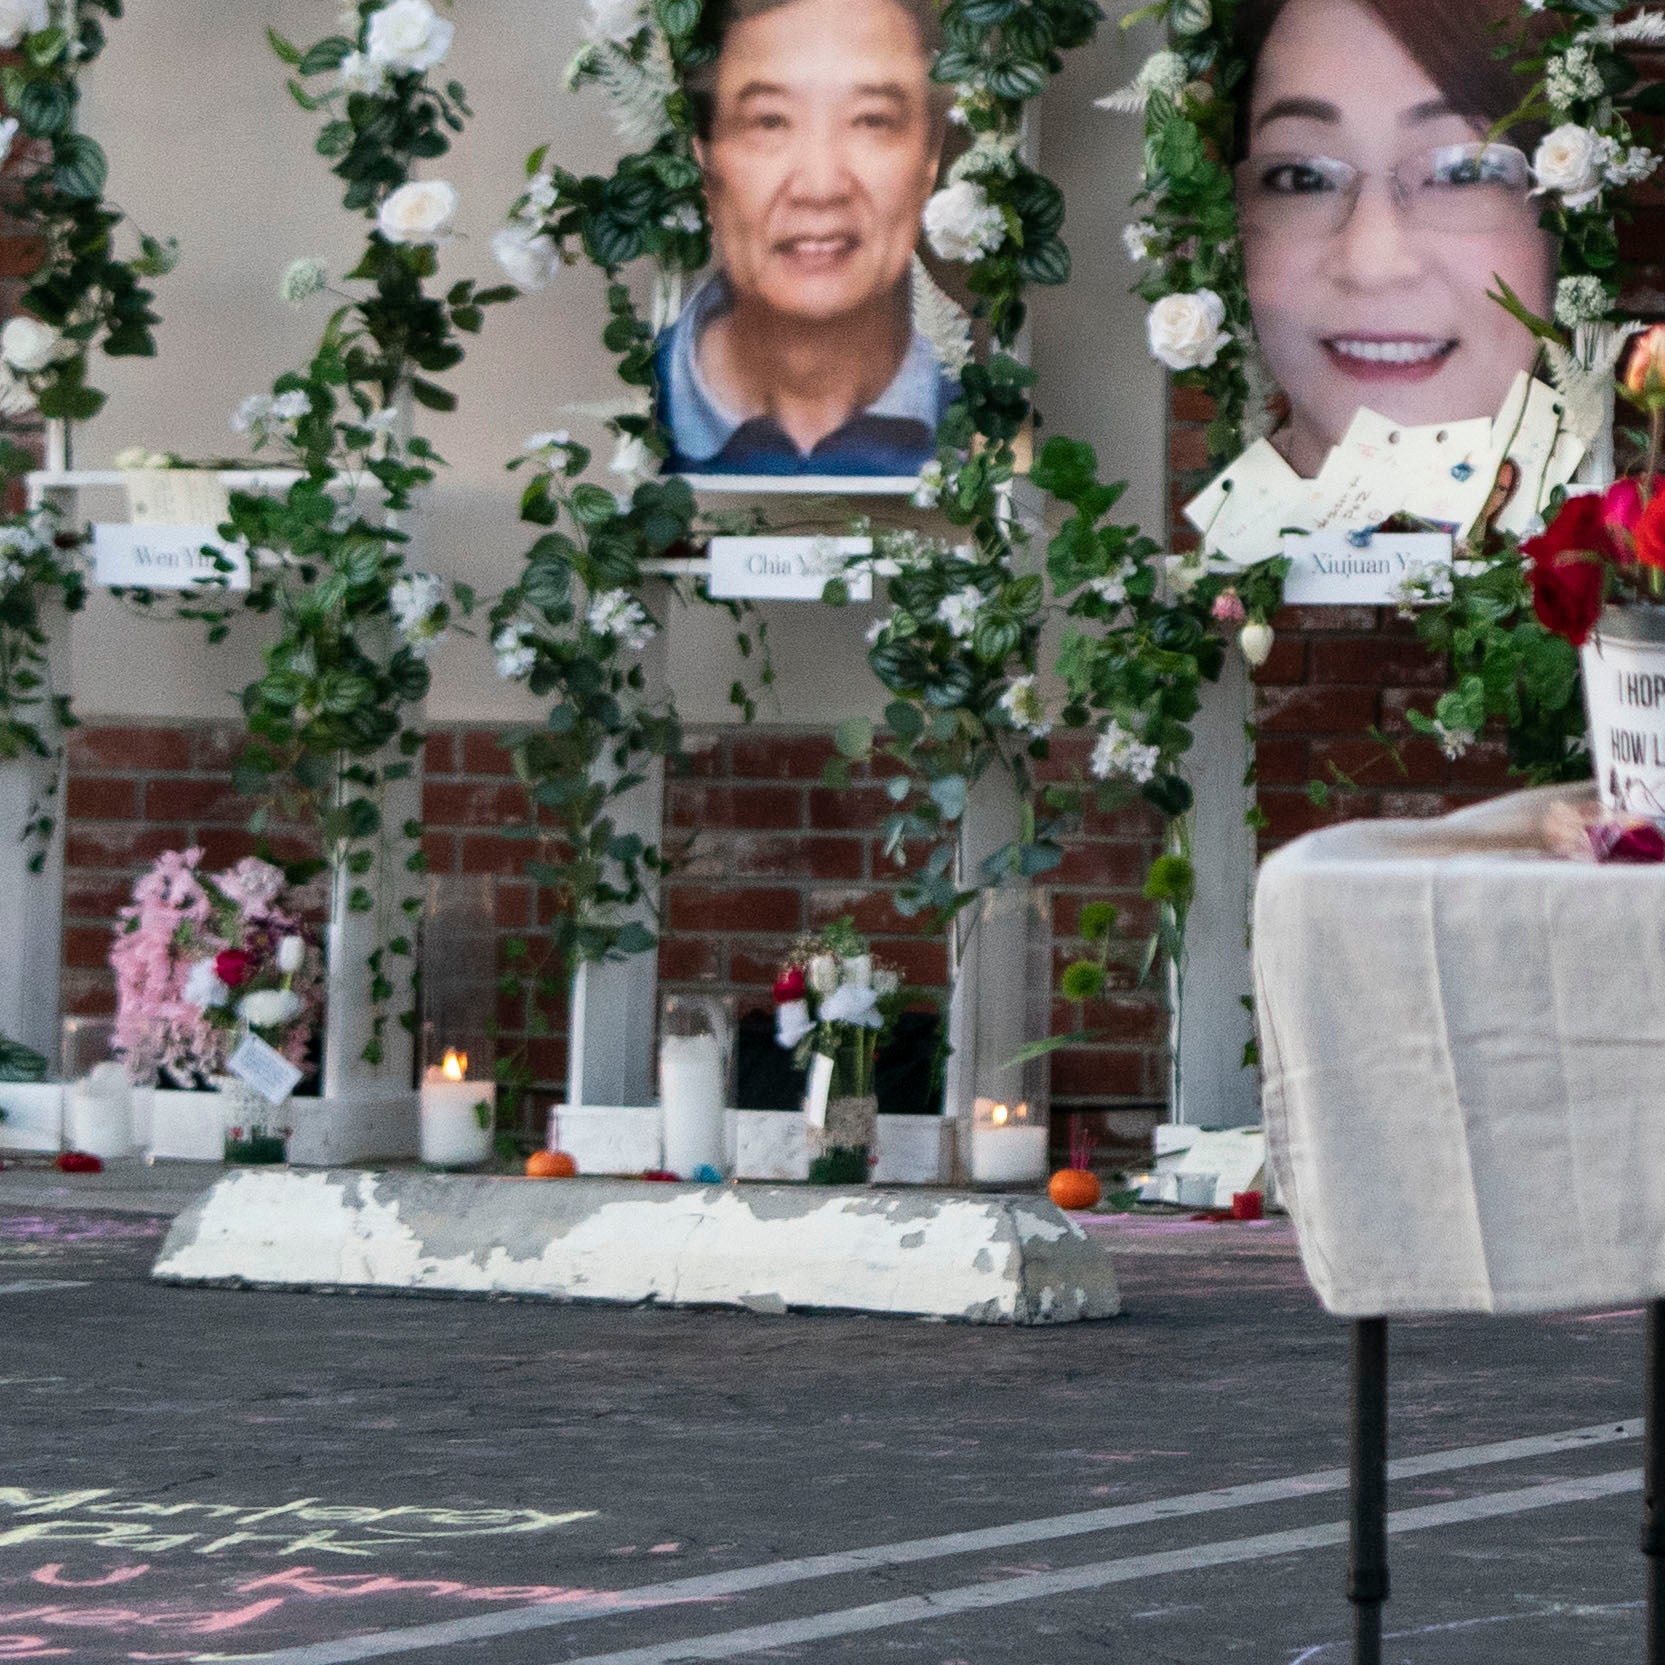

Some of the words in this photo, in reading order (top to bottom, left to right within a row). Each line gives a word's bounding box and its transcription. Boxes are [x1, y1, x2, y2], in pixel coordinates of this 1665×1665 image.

[748, 553, 792, 576] Chia
[1312, 552, 1391, 578] Xiujuan
[1618, 669, 1624, 705] I
[1611, 727, 1647, 766] HOW
[0, 1486, 599, 1537] Monterey
[0, 1520, 421, 1557] Park
